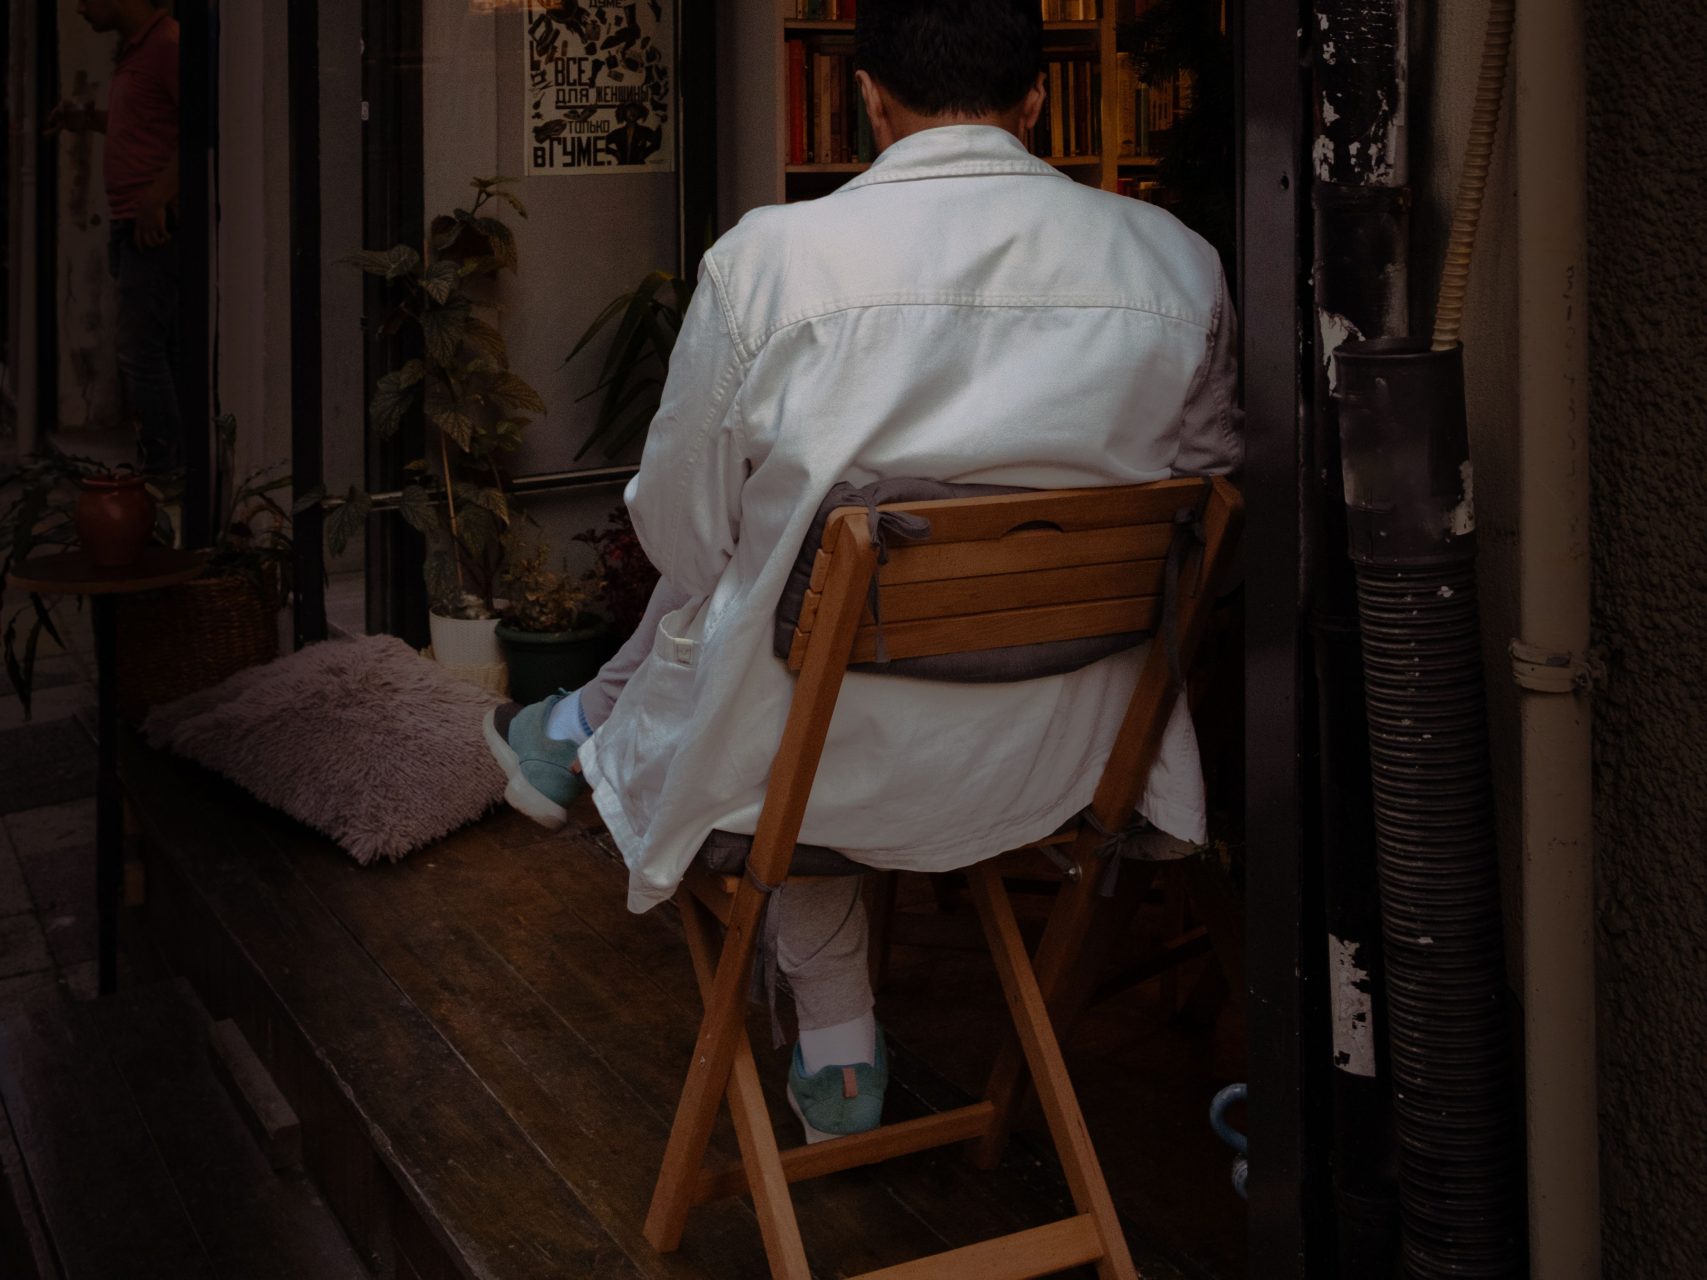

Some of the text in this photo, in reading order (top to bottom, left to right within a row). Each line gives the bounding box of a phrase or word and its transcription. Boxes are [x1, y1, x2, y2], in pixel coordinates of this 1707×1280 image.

[554, 57, 590, 87] ВСЕ
[555, 88, 590, 104] ДЛЯ
[568, 120, 611, 134] ТОЛЬКО
